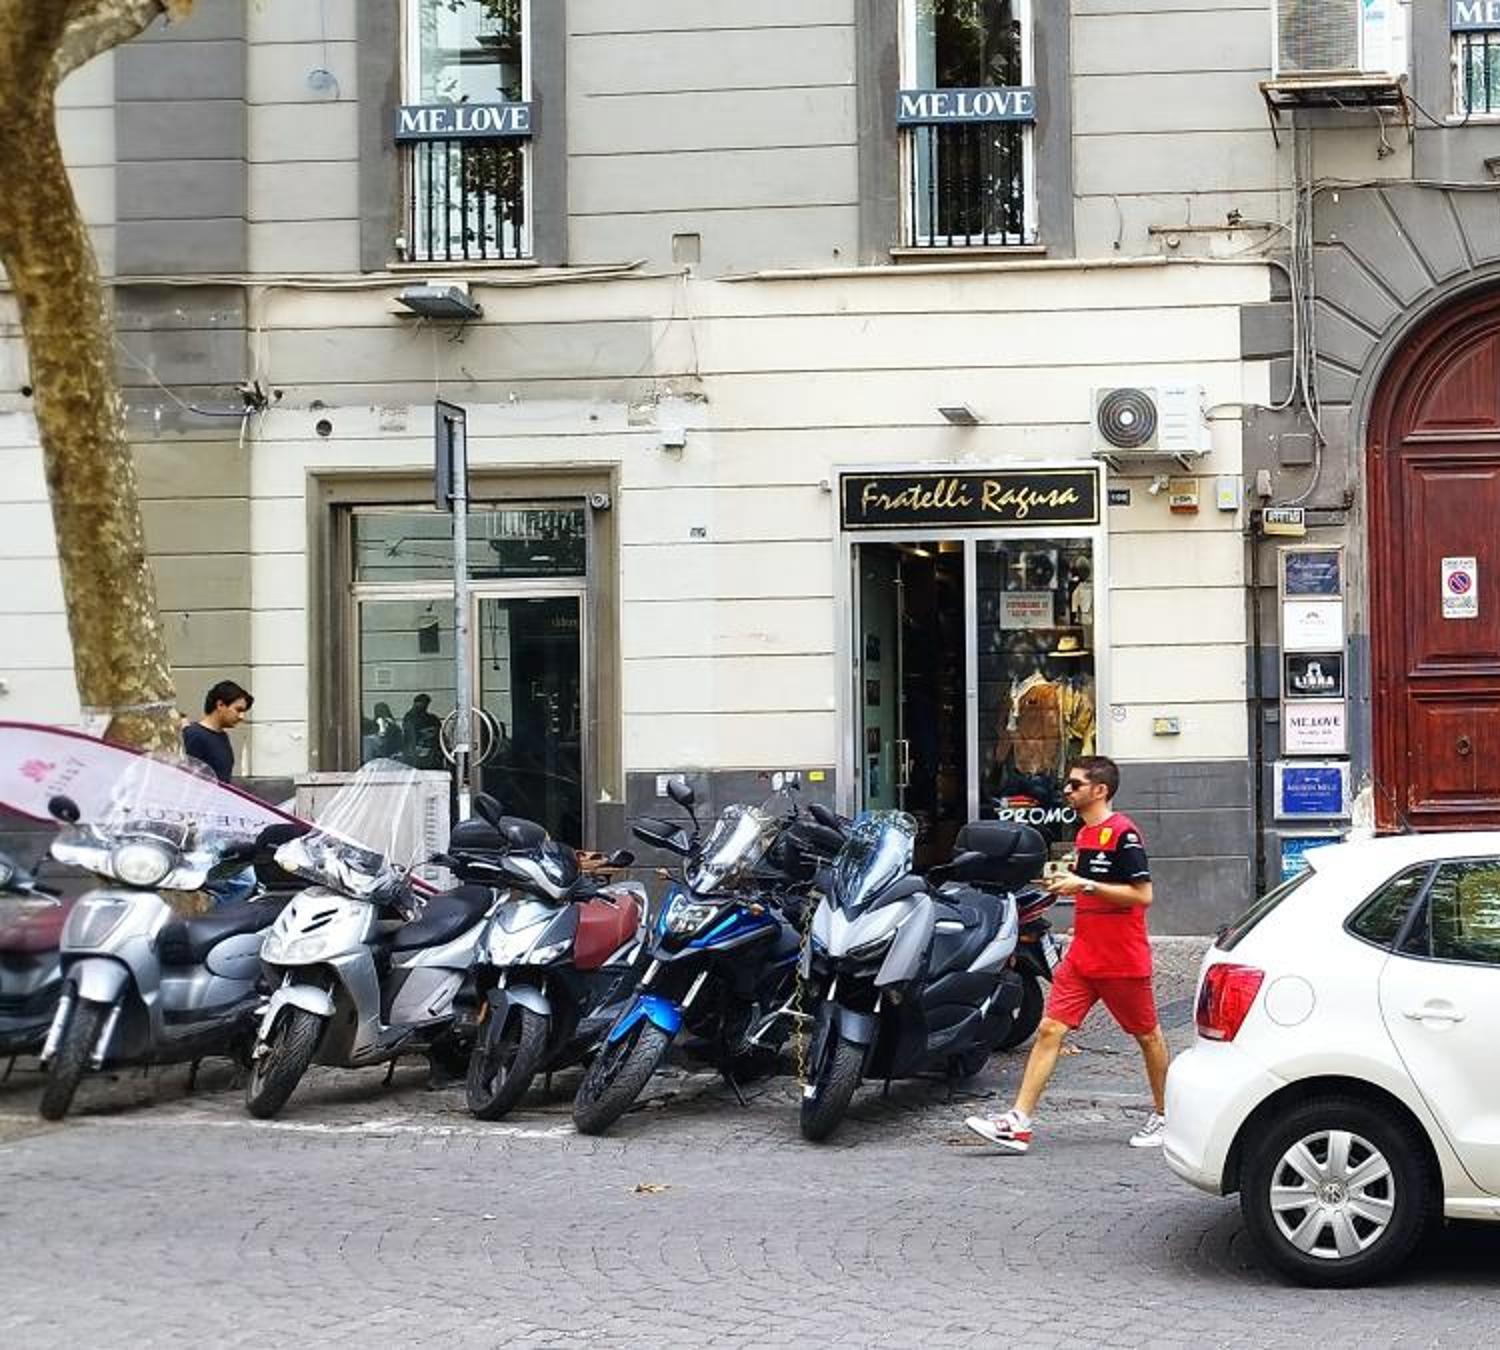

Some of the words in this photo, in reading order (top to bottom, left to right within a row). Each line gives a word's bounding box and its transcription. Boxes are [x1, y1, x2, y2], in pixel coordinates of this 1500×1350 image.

[900, 91, 1034, 118] ME.LOVE
[400, 106, 529, 133] ME.LOVE
[861, 478, 974, 517] Fratelli
[980, 479, 1080, 518] Ragusa
